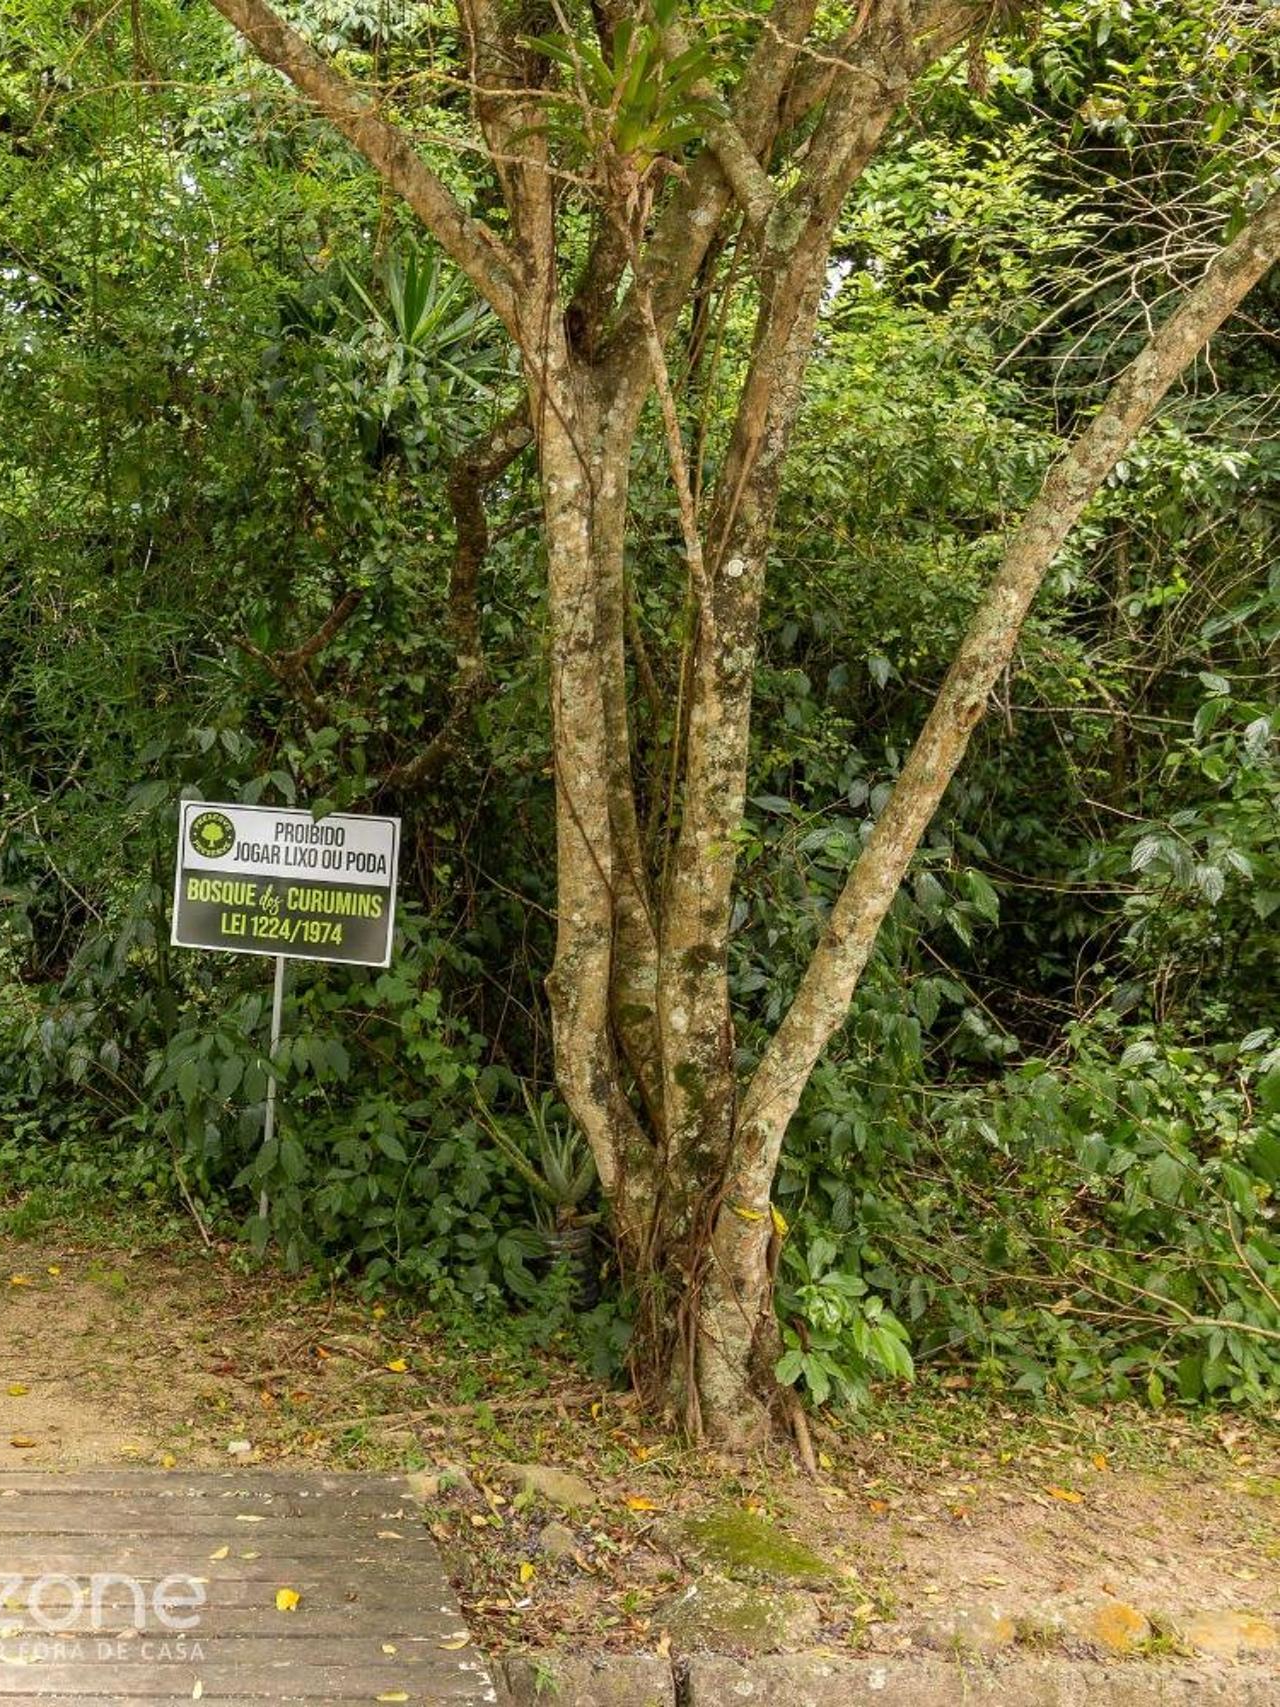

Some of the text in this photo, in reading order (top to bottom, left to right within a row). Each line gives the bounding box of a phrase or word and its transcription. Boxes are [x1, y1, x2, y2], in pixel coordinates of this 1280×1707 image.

[274, 822, 345, 847] PROIBIDO
[233, 841, 280, 865] JOGAR
[284, 846, 317, 868] LIXO
[321, 849, 342, 870] OU
[346, 852, 387, 875] PODA
[187, 878, 383, 918] BOSQUE dos CURUMINS
[221, 912, 342, 945] LEI 1224/1974
